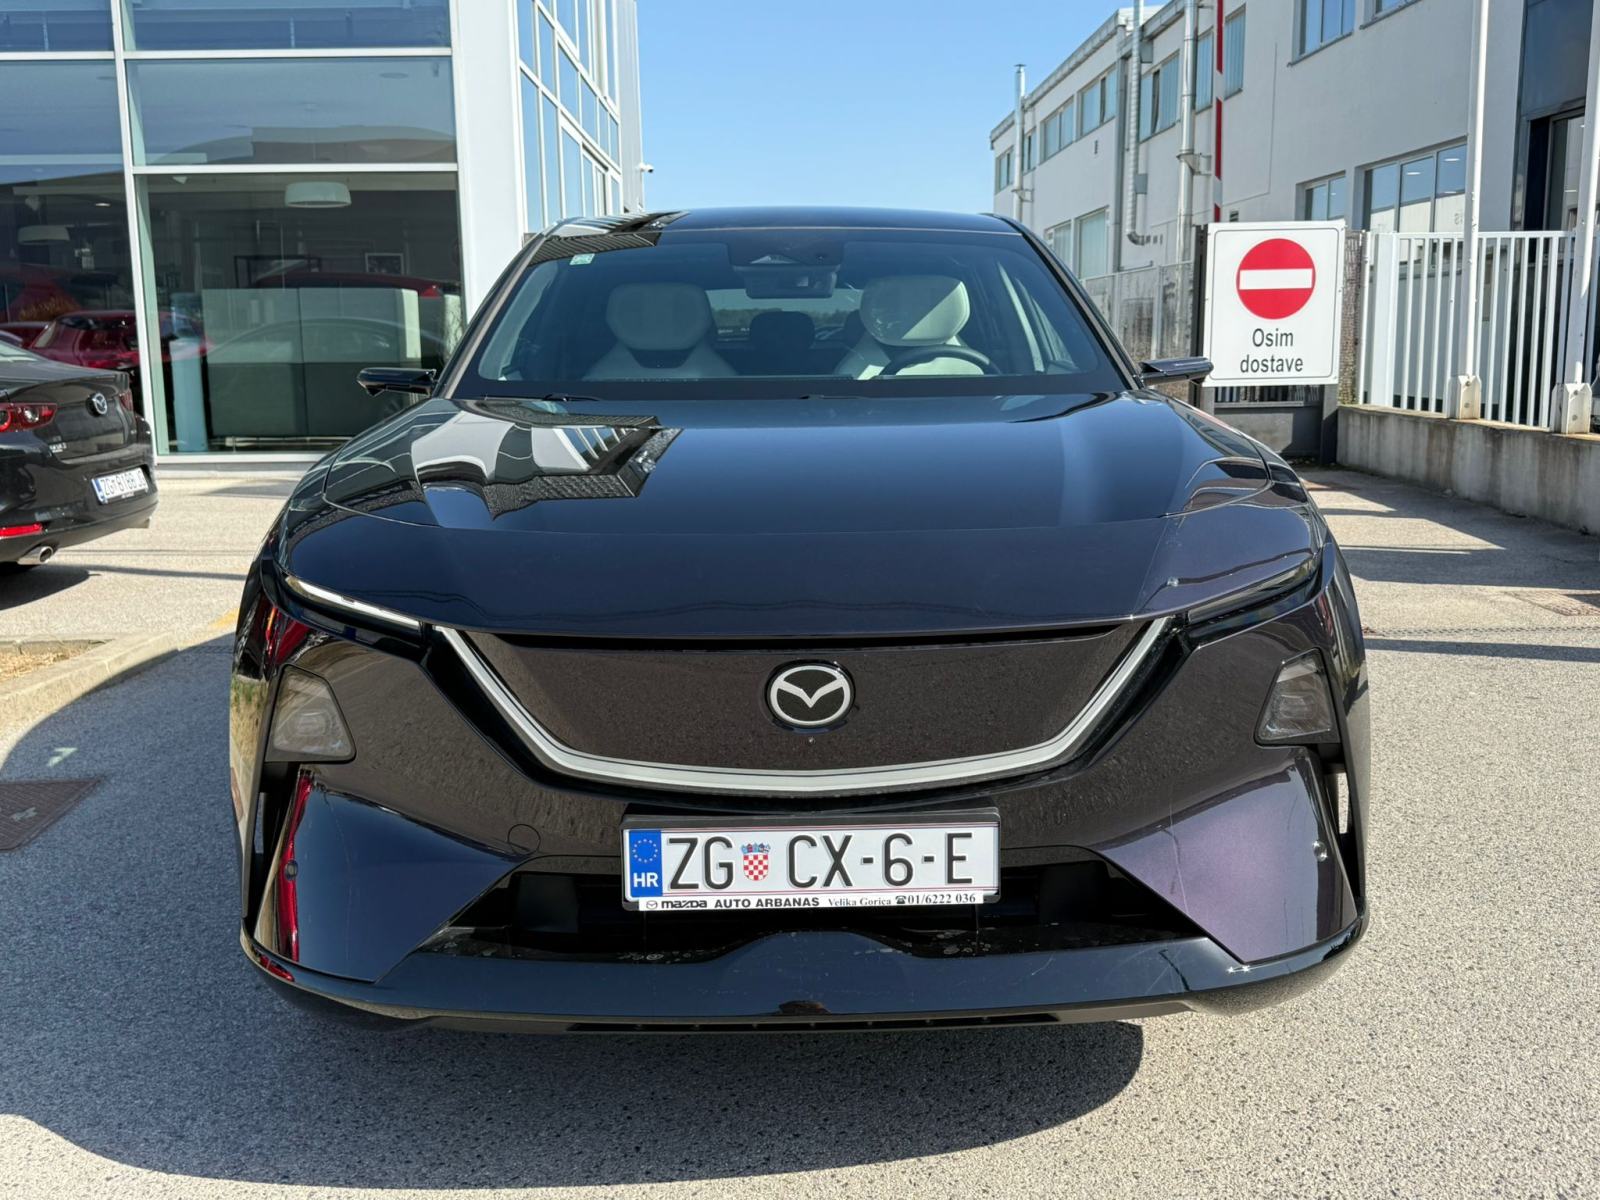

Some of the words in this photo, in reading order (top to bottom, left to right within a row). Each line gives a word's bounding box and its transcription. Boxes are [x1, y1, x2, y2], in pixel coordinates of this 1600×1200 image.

[1252, 328, 1293, 347] Osim
[1240, 354, 1304, 373] dostave
[668, 836, 734, 890] ZG
[788, 831, 973, 888] CX-6-E
[633, 873, 659, 888] HR
[714, 898, 751, 908] AUTO
[755, 897, 820, 908] ARBANAS
[828, 898, 857, 907] Velika
[859, 897, 892, 906] Gorica
[955, 893, 976, 904] 036
